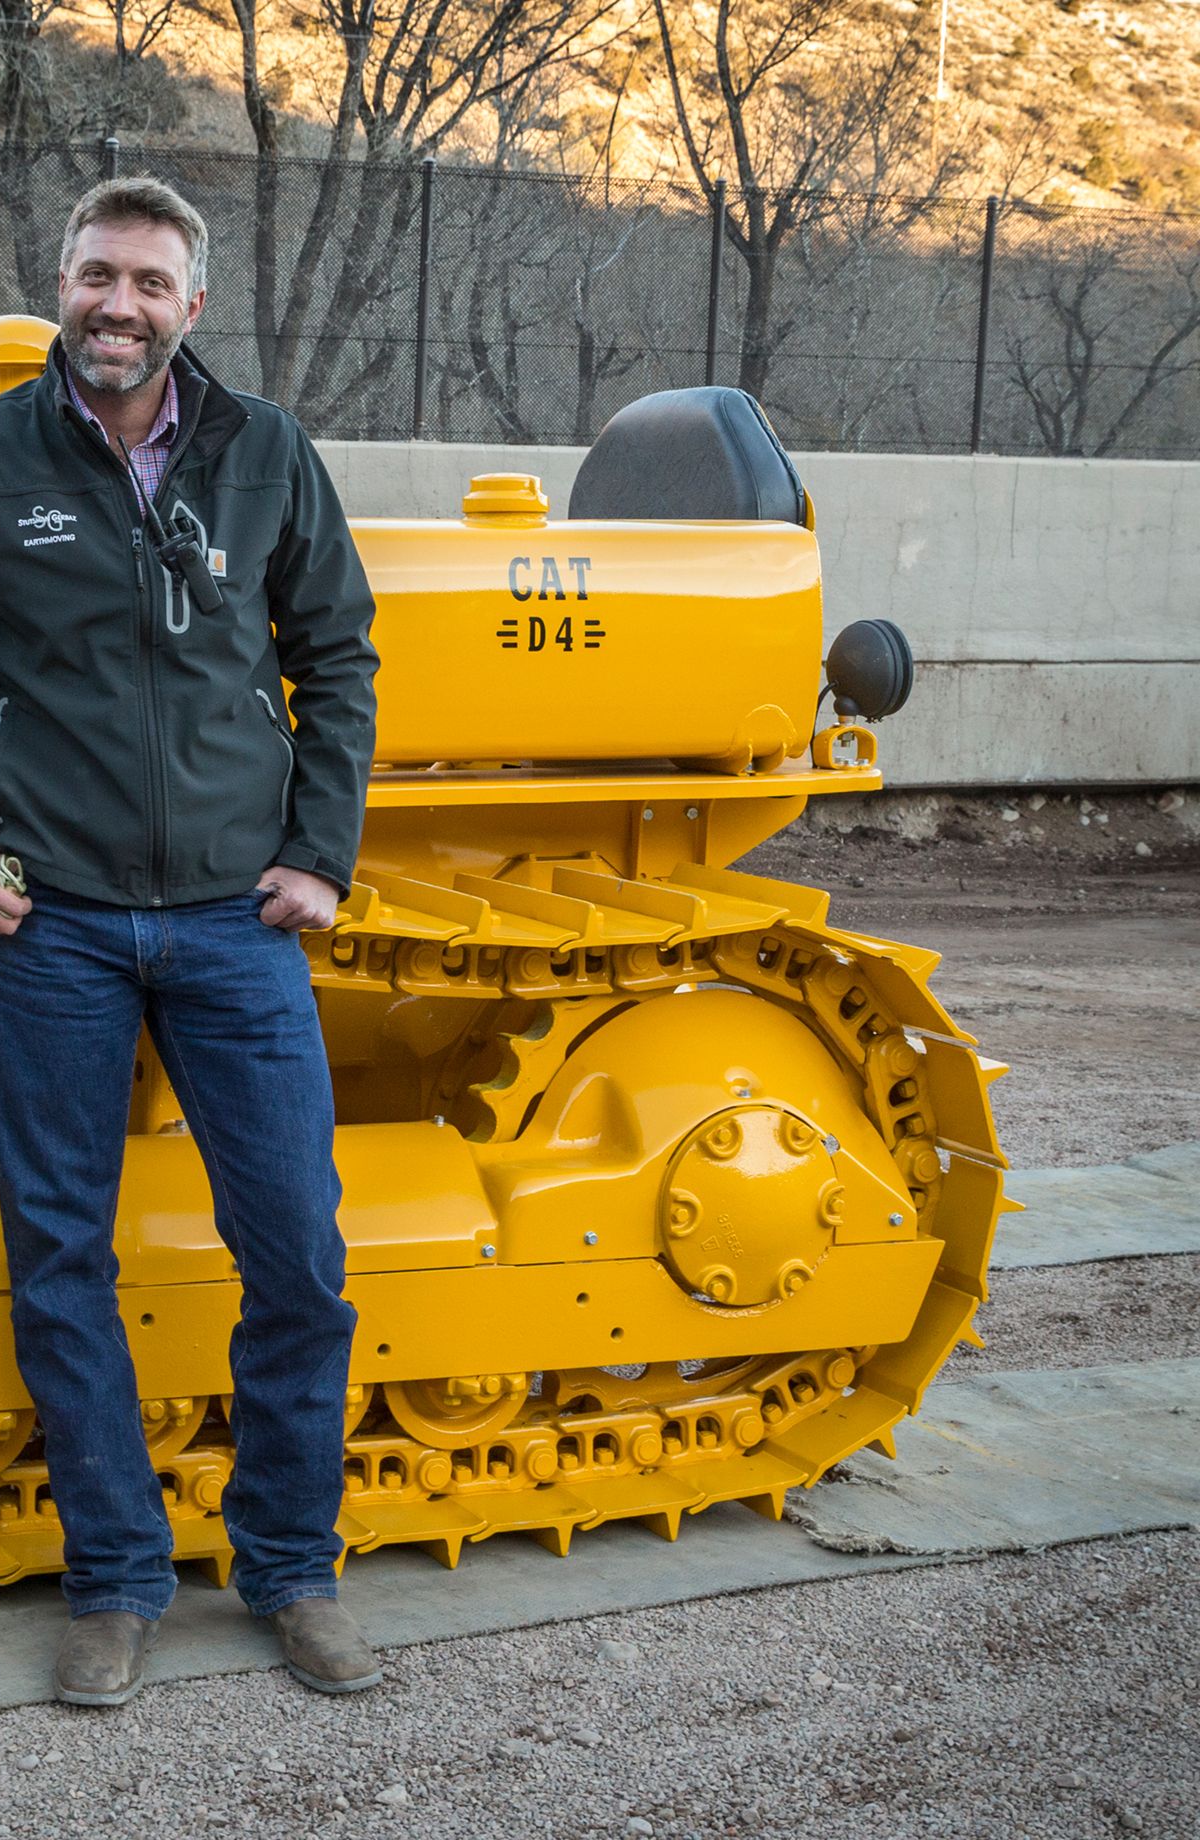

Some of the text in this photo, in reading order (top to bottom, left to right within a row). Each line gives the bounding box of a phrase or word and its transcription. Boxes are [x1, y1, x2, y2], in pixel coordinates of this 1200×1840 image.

[24, 533, 76, 546] EARTHMOVING
[508, 556, 592, 602] CAT
[527, 616, 574, 652] D4
